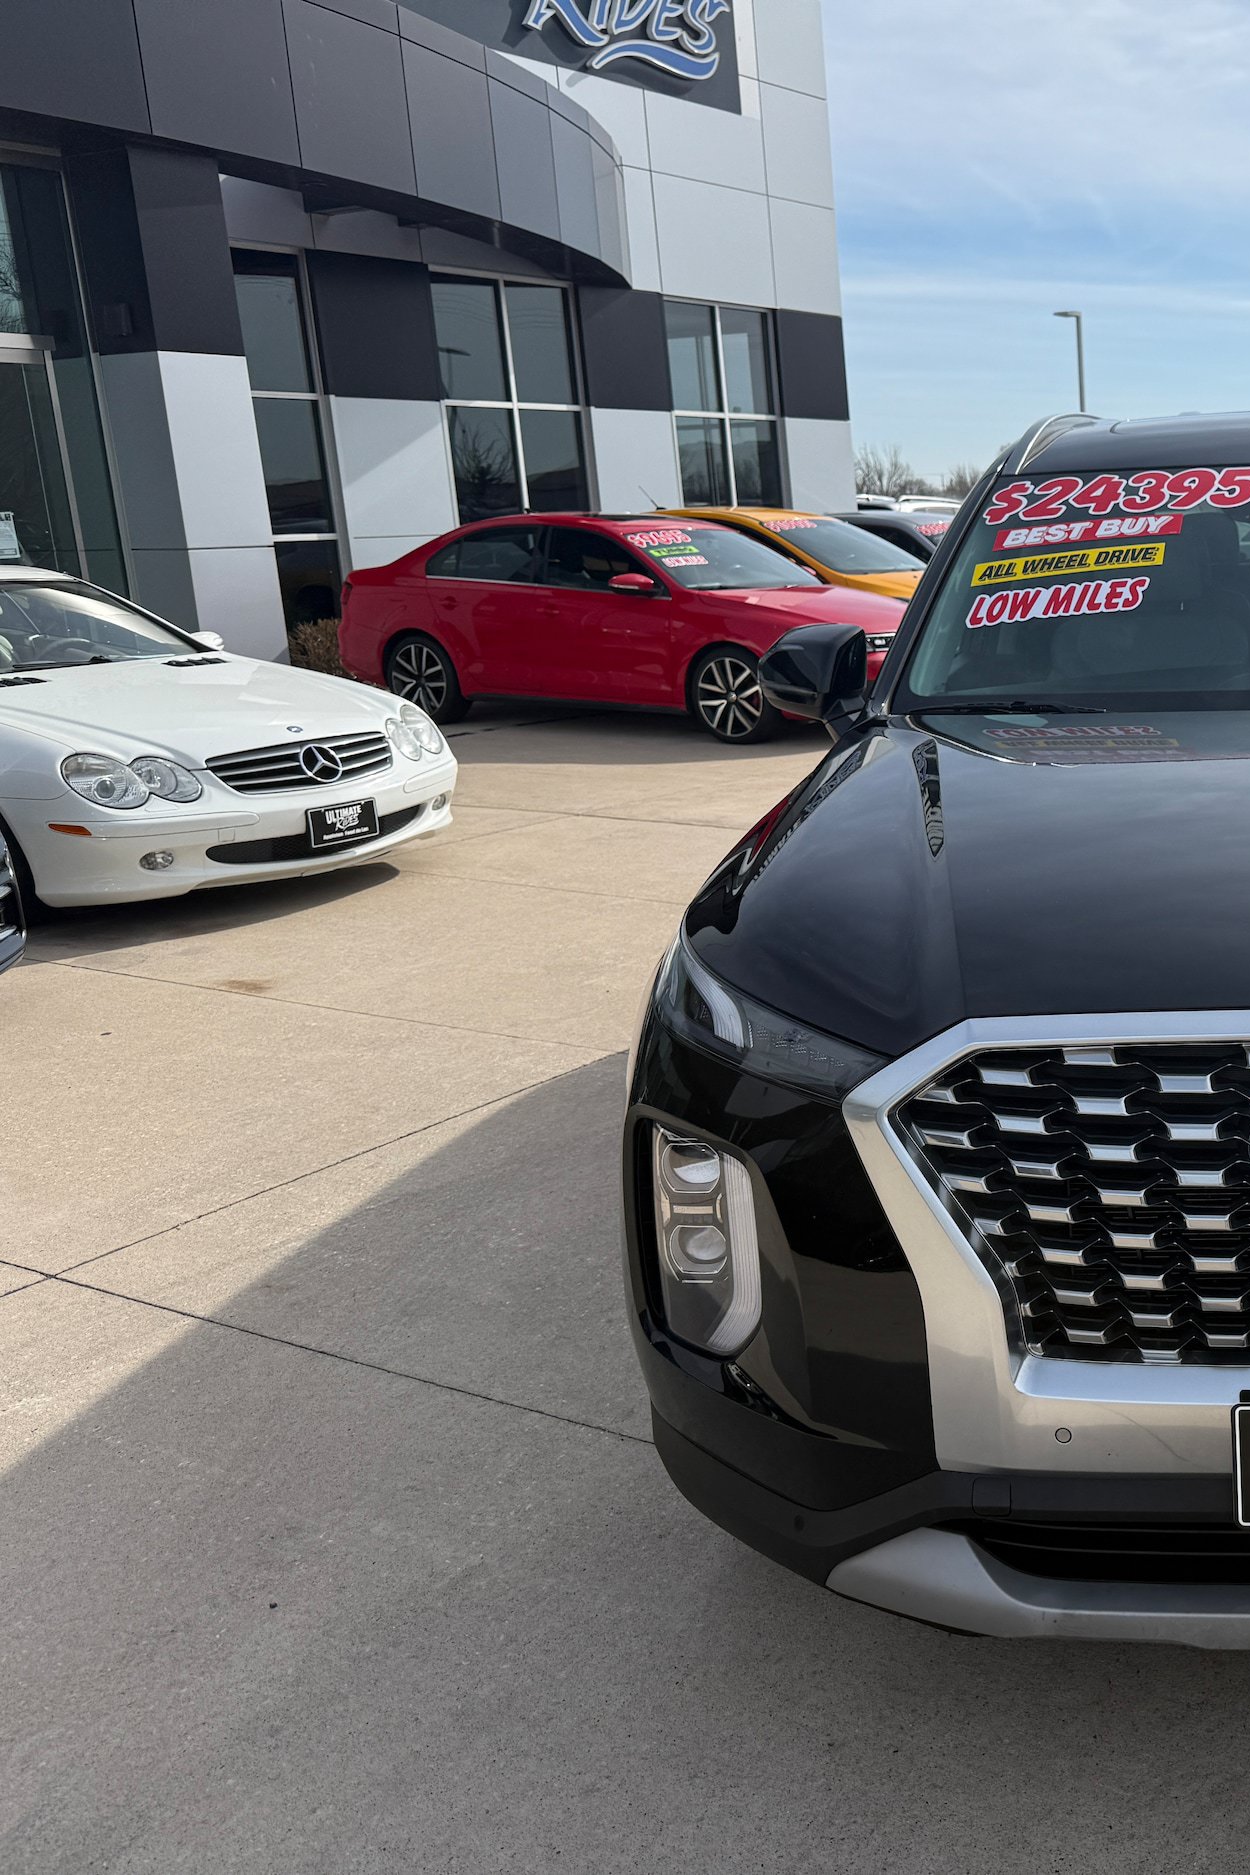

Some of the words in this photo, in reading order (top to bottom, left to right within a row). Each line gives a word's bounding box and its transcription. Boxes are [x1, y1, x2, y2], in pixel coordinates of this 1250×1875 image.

[1002, 522, 1093, 548] BEST
[1095, 515, 1175, 536] BUY
[978, 562, 1017, 581] ALL
[1021, 552, 1090, 575] WHEEL
[1093, 546, 1160, 567] DRIVE
[966, 588, 1042, 628] LOW
[1042, 577, 1150, 617] MILES
[325, 805, 362, 825] ULTIMATE
